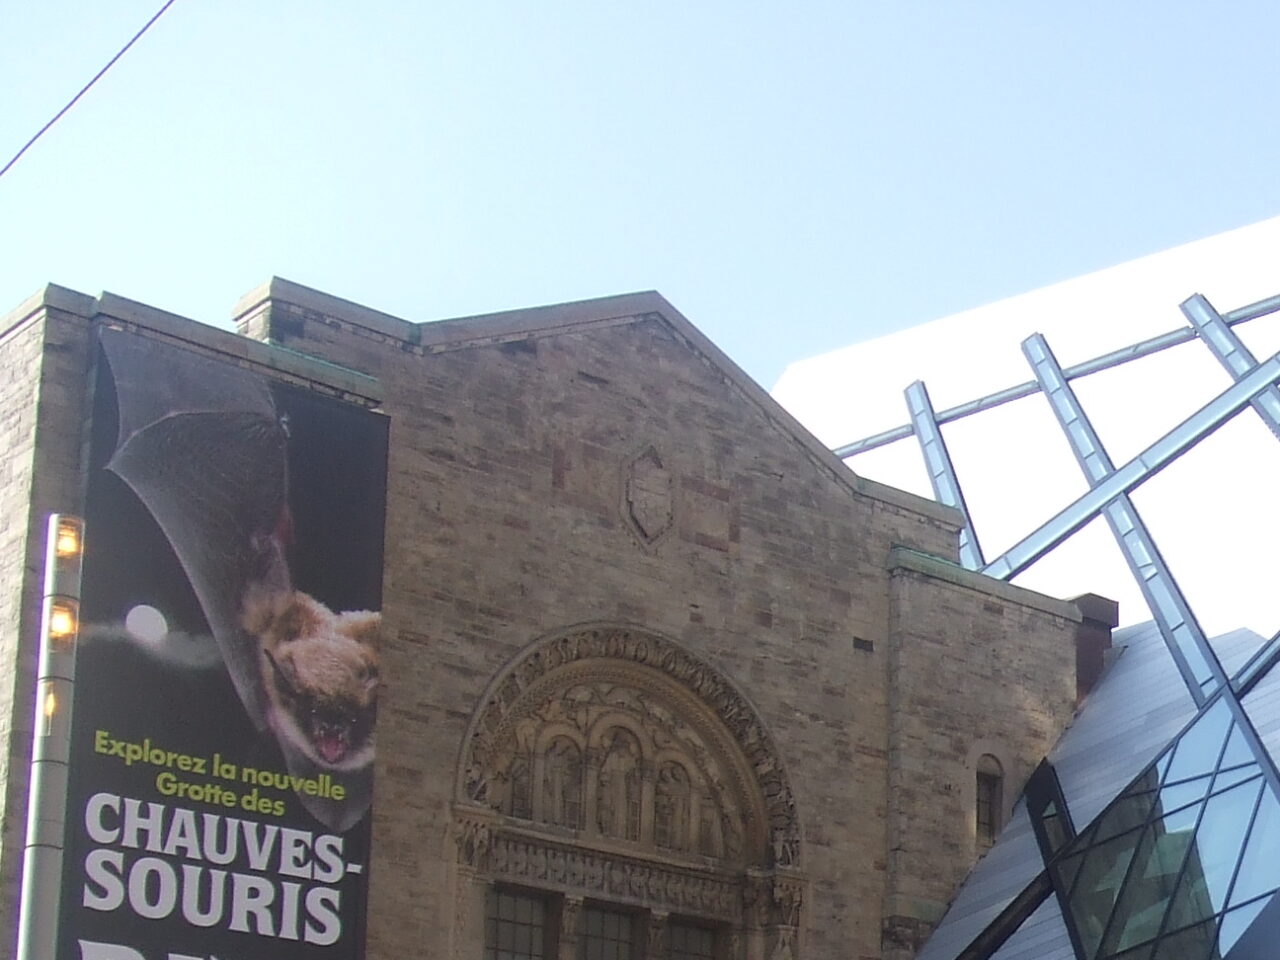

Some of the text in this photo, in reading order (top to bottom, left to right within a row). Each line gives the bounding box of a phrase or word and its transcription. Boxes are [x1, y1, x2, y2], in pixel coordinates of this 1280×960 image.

[93, 731, 346, 801] Explorez la nouvelle
[155, 773, 286, 817] Grotte des
[84, 792, 363, 884] CHAUVES-
[83, 850, 341, 945] SOURIS
